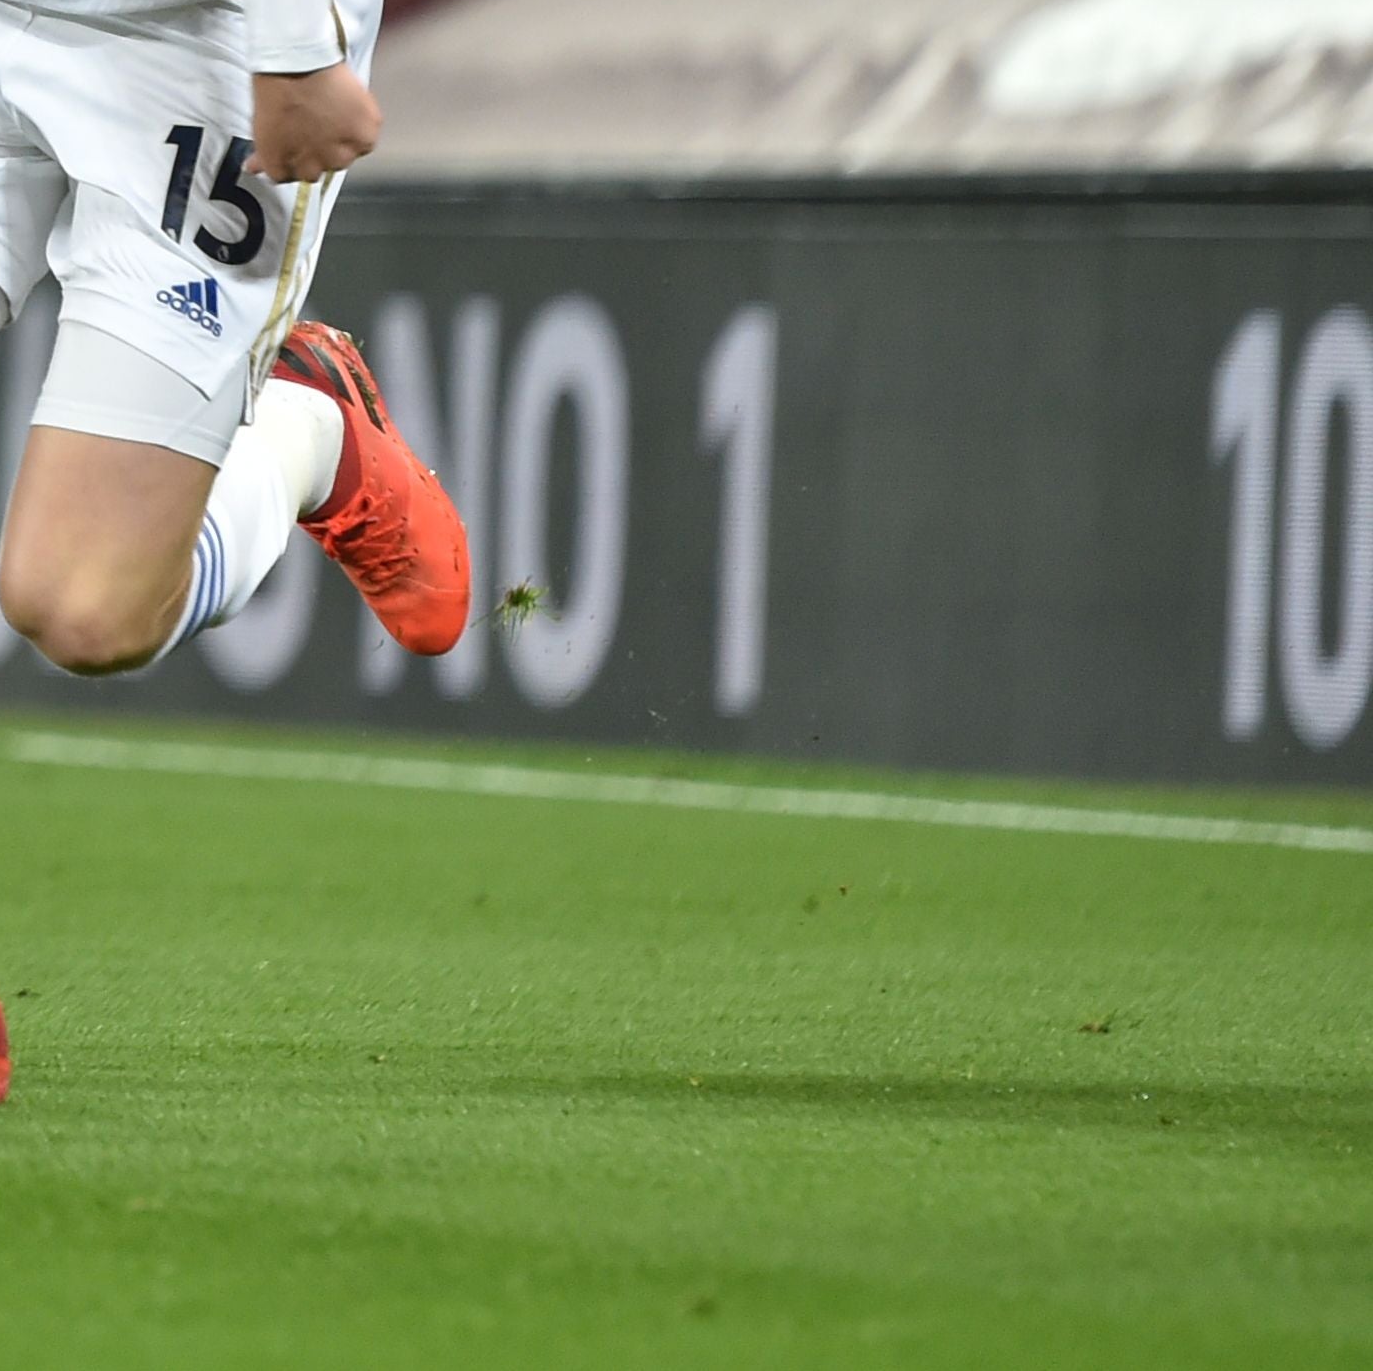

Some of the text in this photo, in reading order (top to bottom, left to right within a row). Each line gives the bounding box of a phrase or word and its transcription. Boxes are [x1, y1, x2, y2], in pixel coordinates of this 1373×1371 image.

[161, 124, 267, 266] 15
[156, 289, 223, 338] adidas
[699, 301, 779, 717] 1
